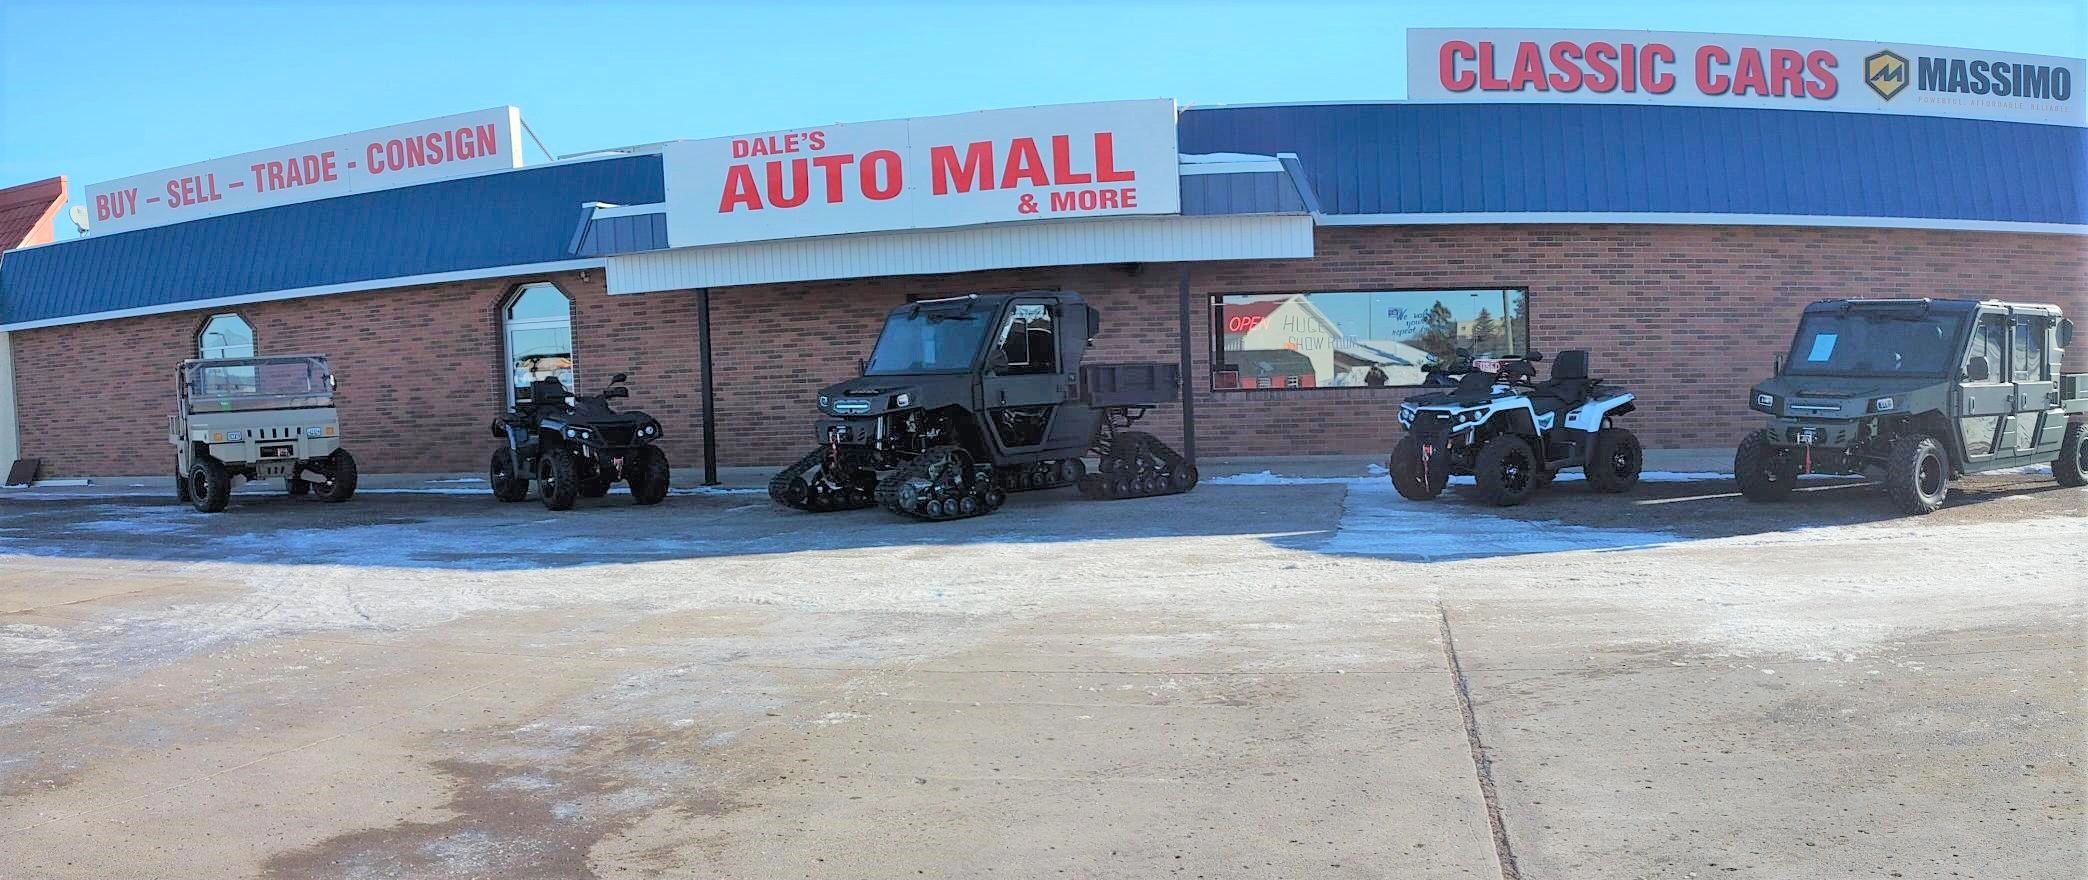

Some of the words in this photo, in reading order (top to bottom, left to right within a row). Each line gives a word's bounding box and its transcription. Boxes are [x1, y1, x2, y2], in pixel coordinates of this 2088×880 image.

[1439, 40, 1675, 94] CLASSIC
[1695, 45, 1838, 99] CARS
[1918, 56, 2071, 101] MASSIMO
[95, 187, 138, 222] BUY
[166, 173, 222, 209] SELL
[251, 151, 338, 194] TRADE
[366, 123, 497, 175] CONSIGN
[718, 149, 904, 214] AUTO
[930, 132, 1136, 196] MALL
[1017, 193, 1039, 215] &
[1050, 187, 1138, 212] MORE
[1229, 316, 1270, 332] OPEN
[1289, 335, 1324, 351] SHOW
[1480, 362, 1500, 372] USED
